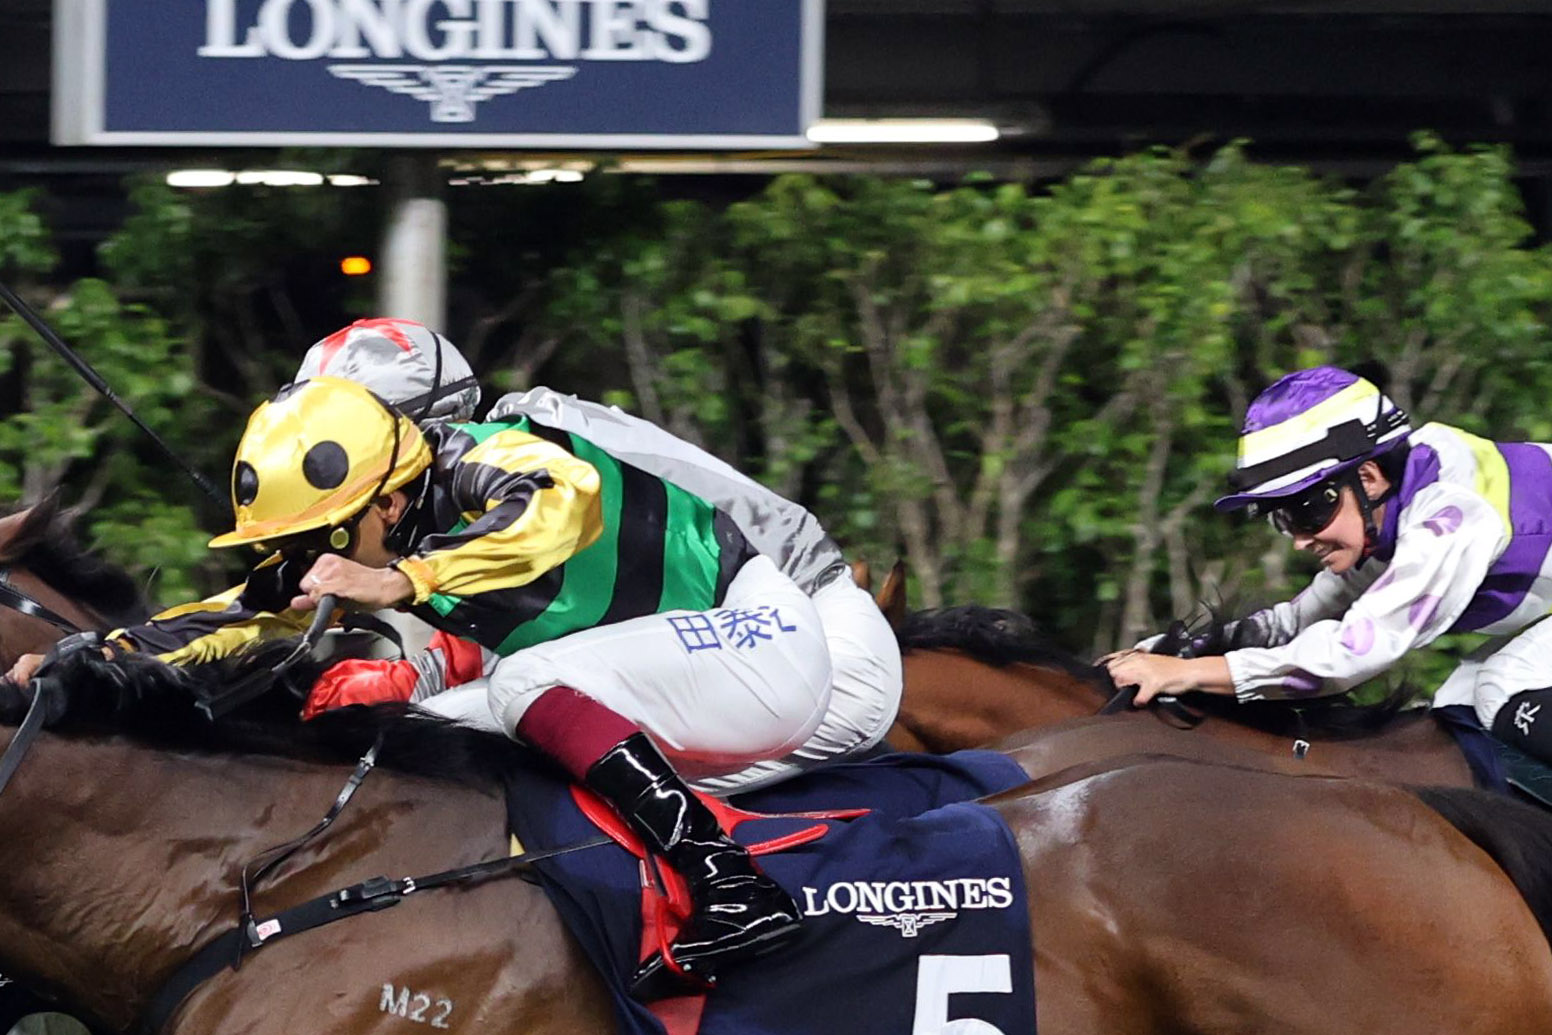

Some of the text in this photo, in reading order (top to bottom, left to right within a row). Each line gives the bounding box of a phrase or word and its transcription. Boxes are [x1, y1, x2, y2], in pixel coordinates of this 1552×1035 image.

[198, 0, 711, 63] LONGINES
[802, 877, 1014, 916] LONGINES
[379, 983, 453, 1029] M22
